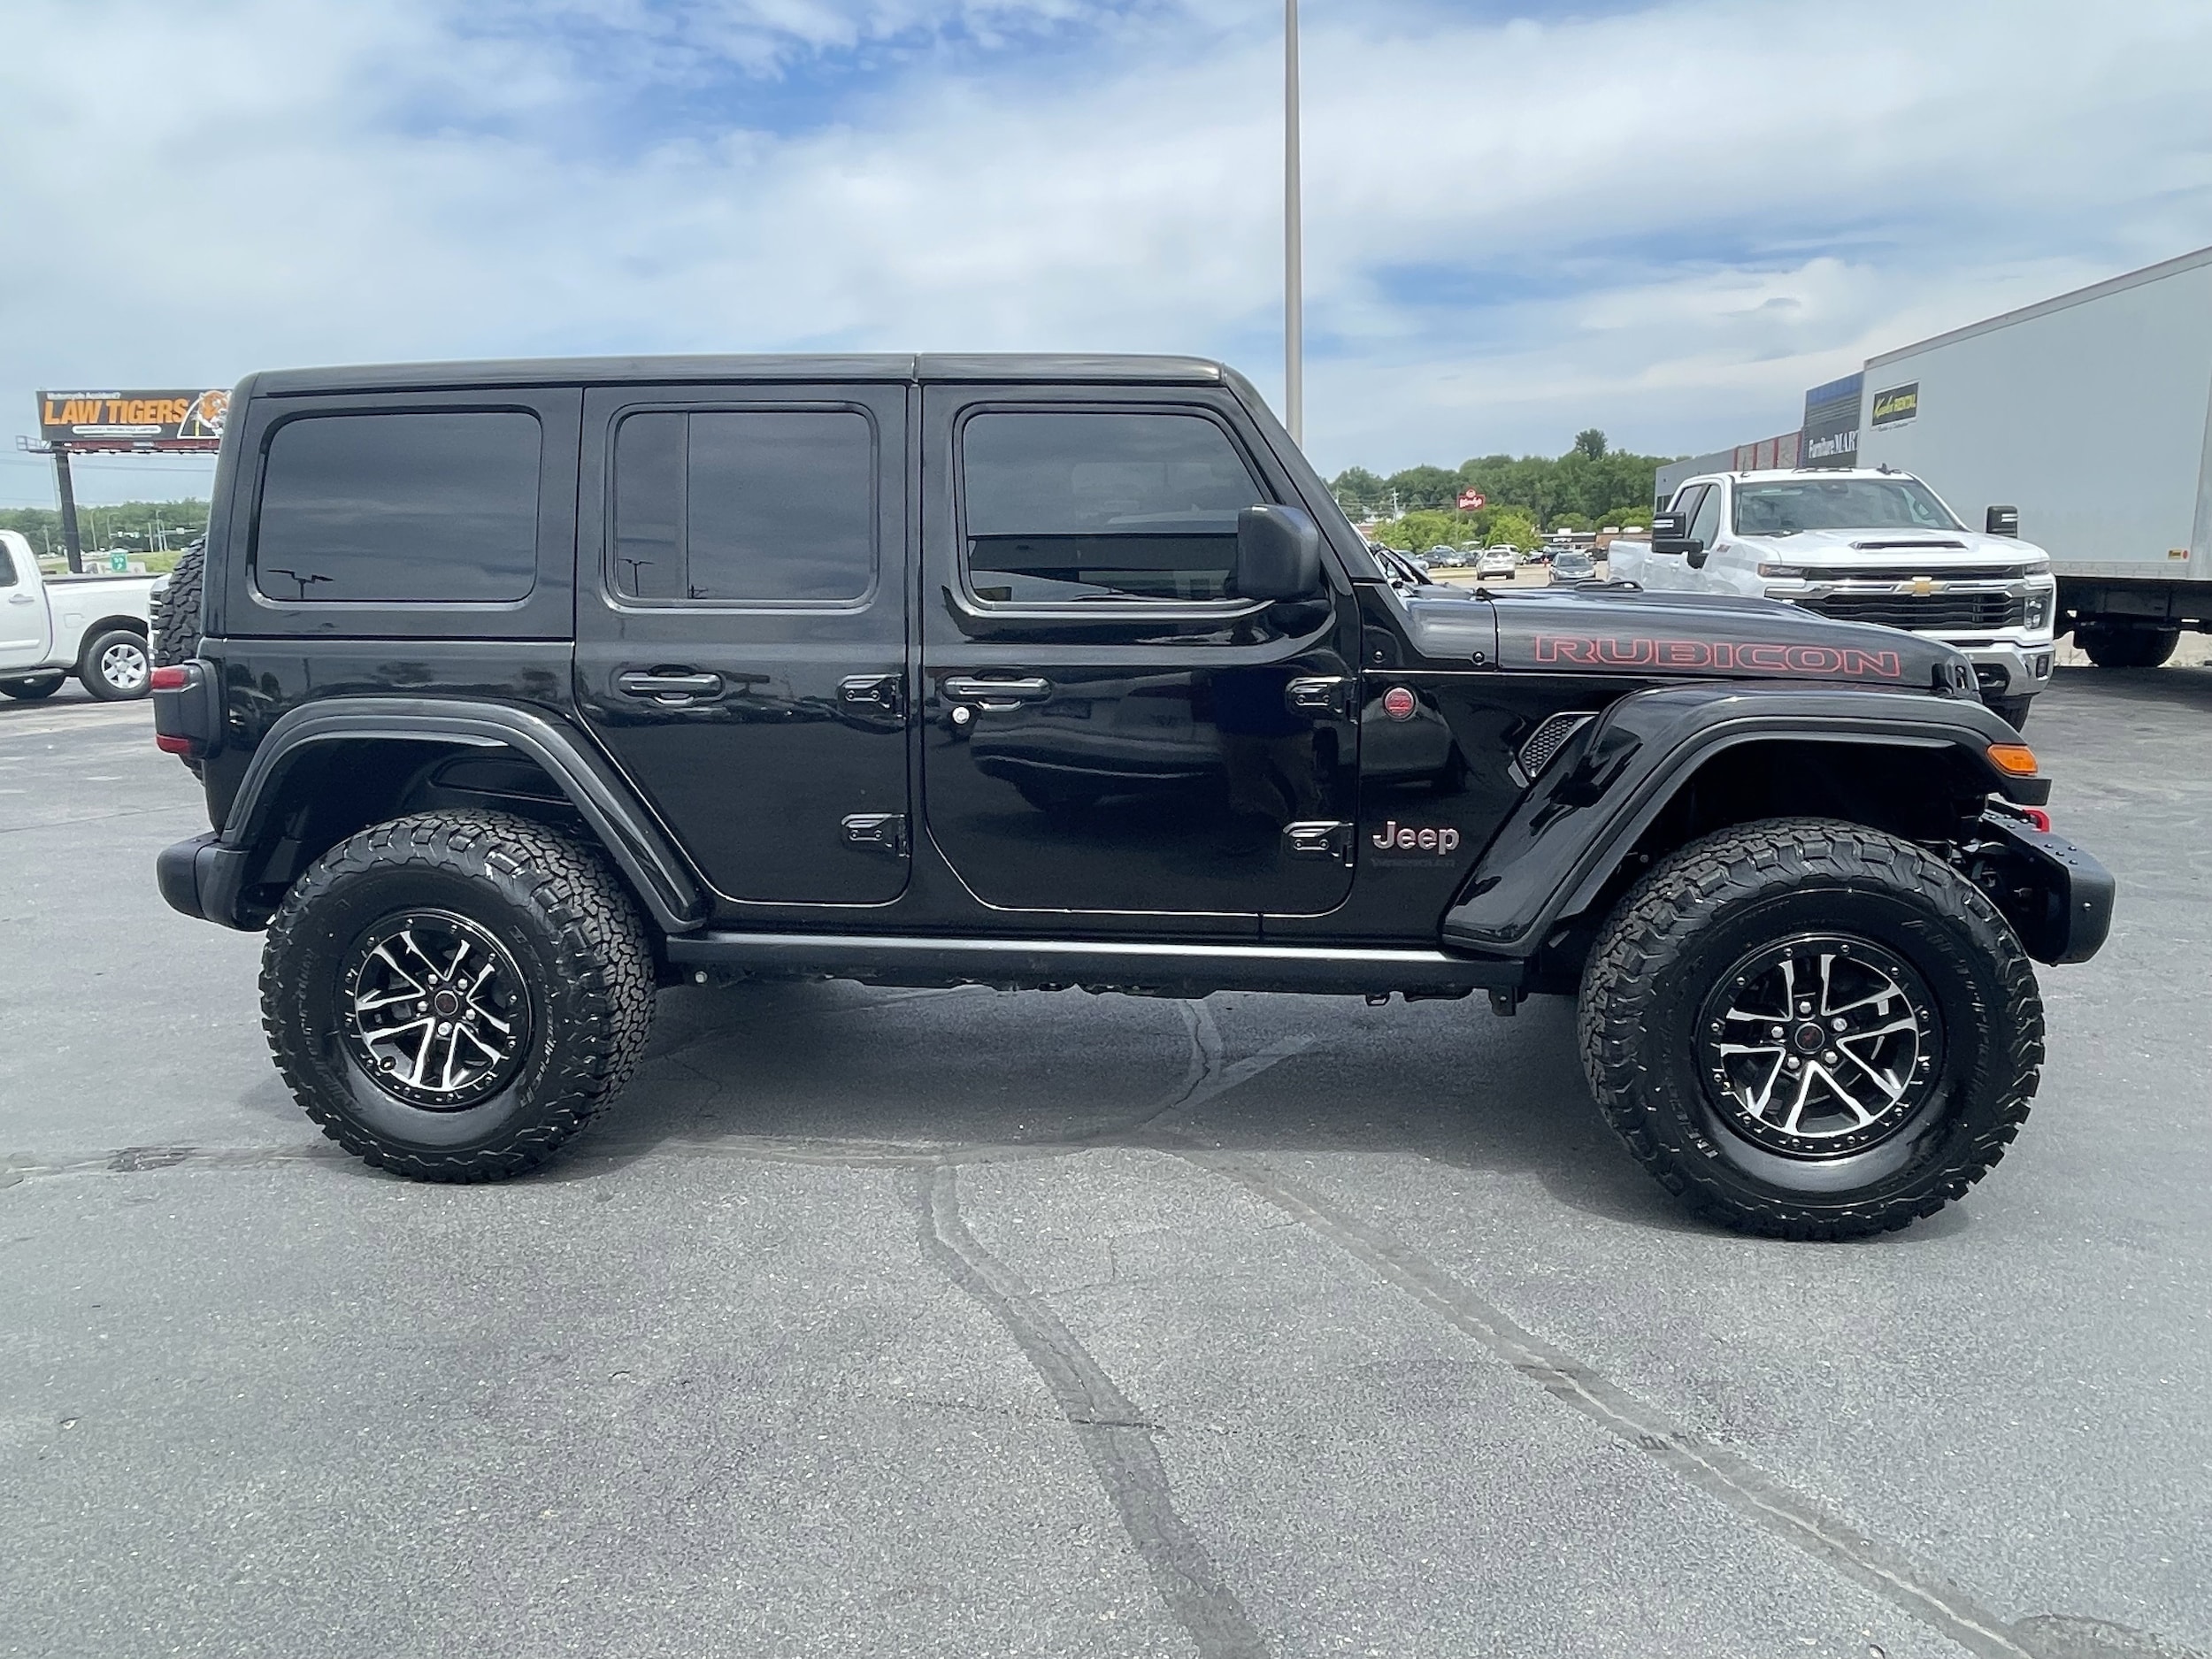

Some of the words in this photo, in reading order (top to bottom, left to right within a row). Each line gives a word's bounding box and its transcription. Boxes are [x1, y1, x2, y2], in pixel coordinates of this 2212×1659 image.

[44, 400, 103, 425] LAW
[105, 398, 189, 425] TIGERS
[1535, 635, 1901, 677] RUBICON
[1372, 820, 1460, 856] Jeep
